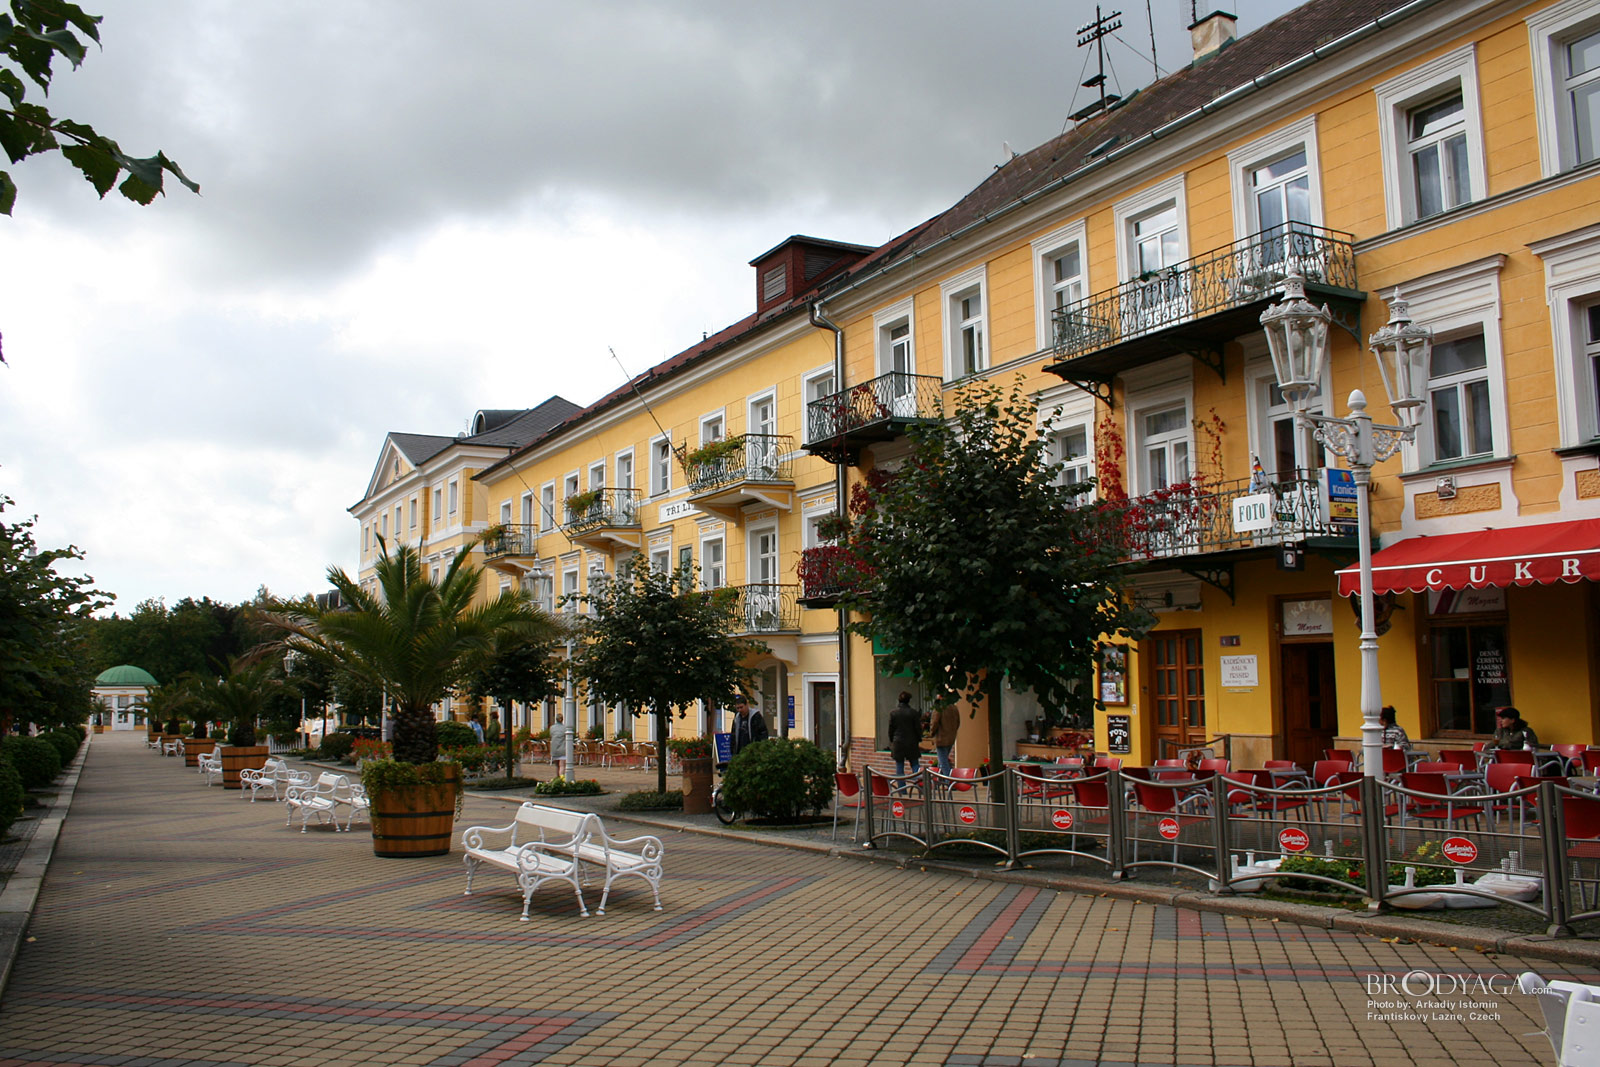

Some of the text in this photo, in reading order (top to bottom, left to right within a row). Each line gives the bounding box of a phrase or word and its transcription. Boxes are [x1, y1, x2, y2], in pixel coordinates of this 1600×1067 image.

[1238, 502, 1266, 523] FOTO
[1425, 557, 1582, 586] CUKR
[1296, 623, 1322, 632] Mozart
[1108, 728, 1128, 738] FOTO
